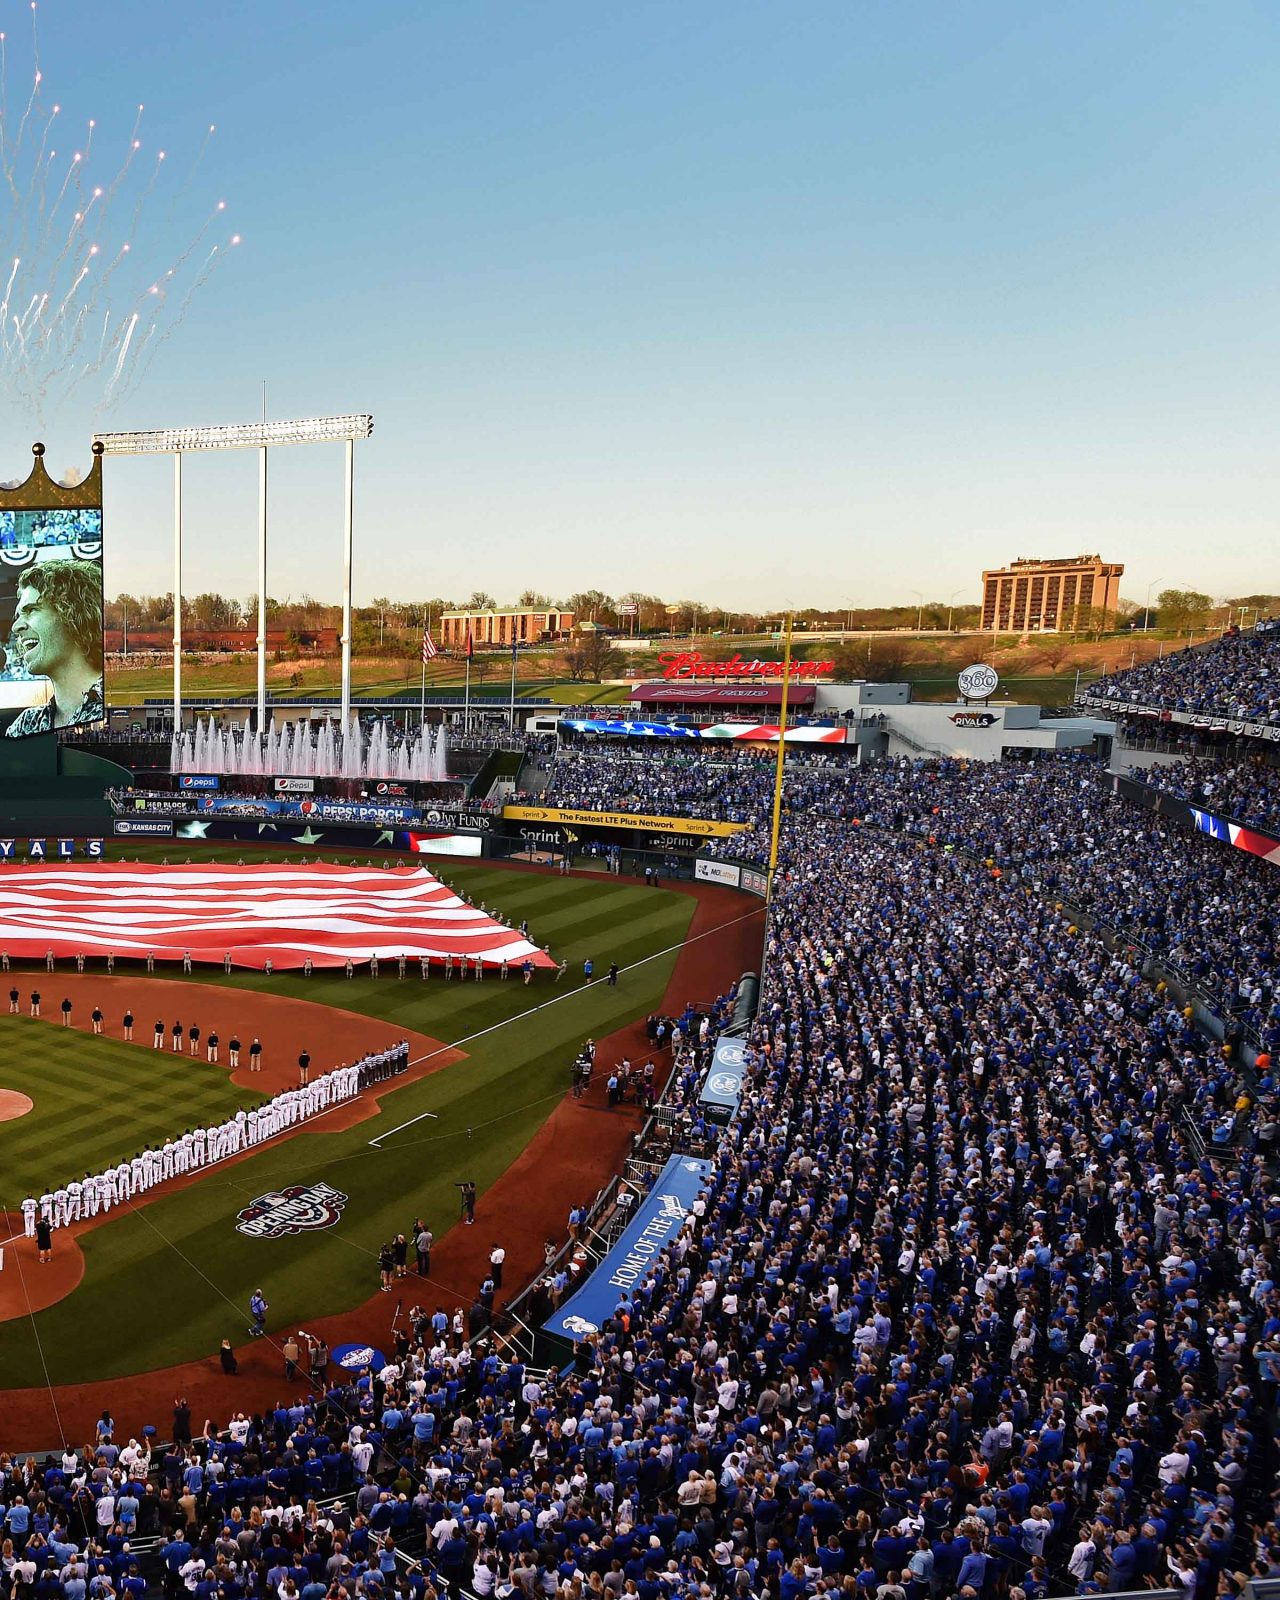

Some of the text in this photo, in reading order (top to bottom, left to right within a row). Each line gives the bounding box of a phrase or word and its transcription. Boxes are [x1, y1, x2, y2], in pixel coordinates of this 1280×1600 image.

[657, 651, 835, 678] Budweiser
[961, 671, 995, 691] 360
[955, 717, 988, 726] RIVALS
[193, 778, 214, 787] pepsi
[289, 781, 309, 790] pepsi
[522, 810, 705, 833] Sprint The Fastest LTE Plus Network Sprint
[520, 827, 560, 844] Sprint
[660, 834, 694, 848] Sprint
[239, 1184, 337, 1236] OPENING DAY
[642, 1216, 673, 1238] THE
[633, 1237, 659, 1254] OF
[608, 1252, 650, 1289] HOME
